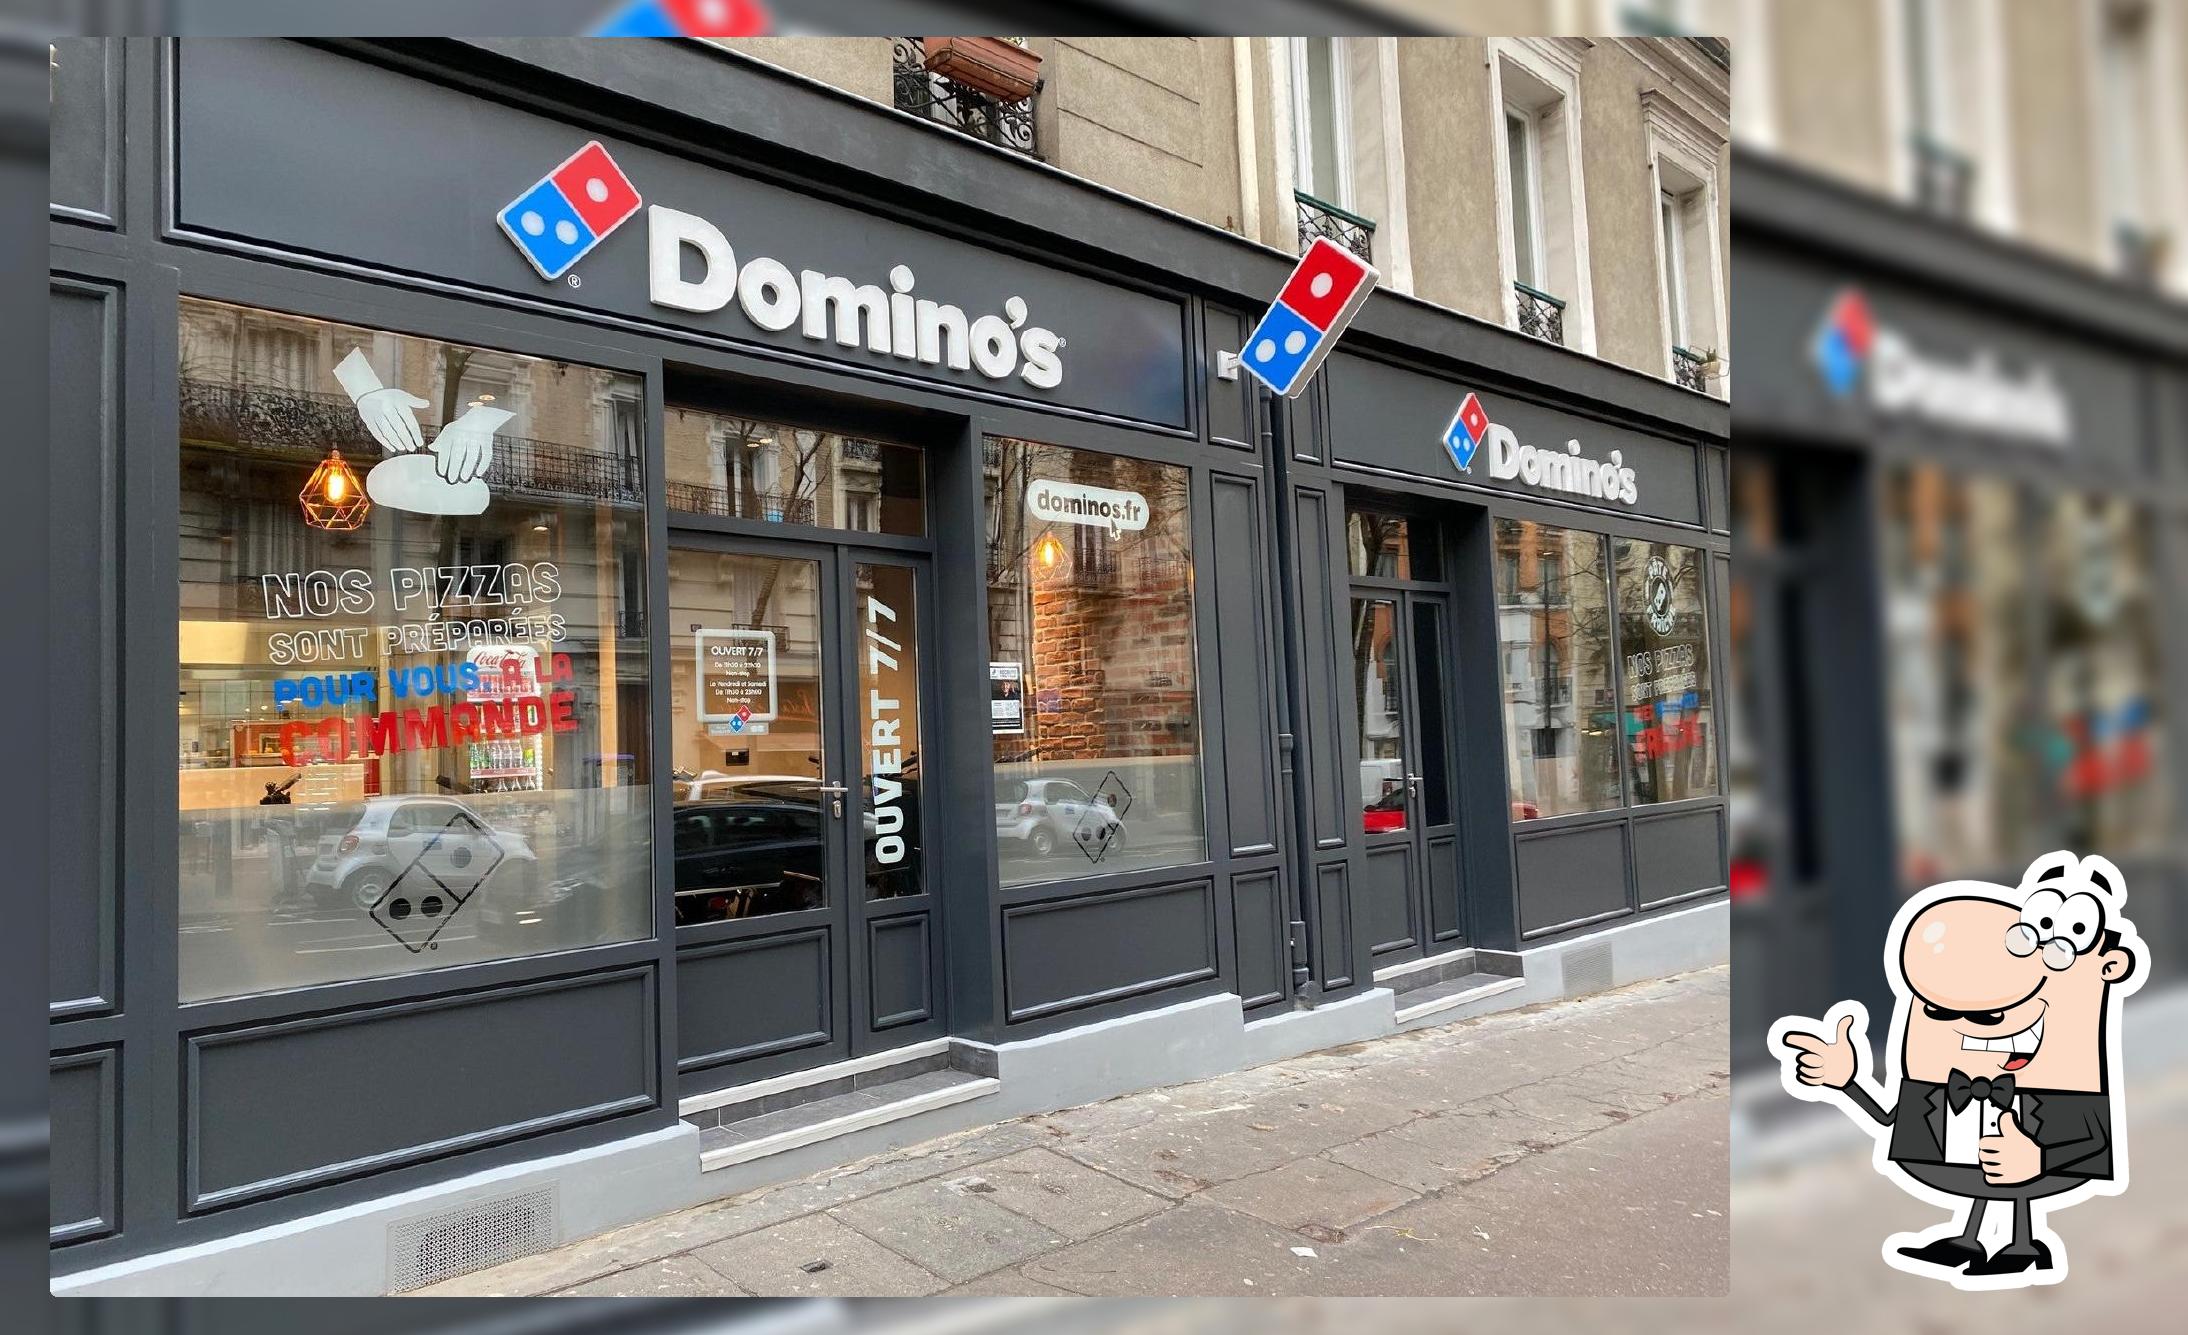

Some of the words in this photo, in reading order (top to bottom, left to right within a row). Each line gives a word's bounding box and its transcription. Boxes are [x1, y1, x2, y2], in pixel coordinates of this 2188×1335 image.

[648, 203, 1064, 389] Domino's
[1488, 422, 1638, 505] Domino's
[1036, 488, 1142, 521] dominos.fr
[262, 568, 375, 619] NOS
[390, 562, 562, 611] PIZZAS
[268, 626, 368, 665] SONT
[381, 606, 567, 657] PRÉPARÉES
[711, 646, 747, 656] OUVERT
[748, 647, 764, 657] 7/7
[865, 595, 902, 676] 7/7
[1627, 651, 1653, 679] NOS
[1654, 644, 1695, 673] PIZZAS
[274, 671, 377, 711] POUR
[534, 652, 574, 683] LA
[279, 691, 580, 768] COMMANDE
[870, 689, 906, 865] OUVERT
